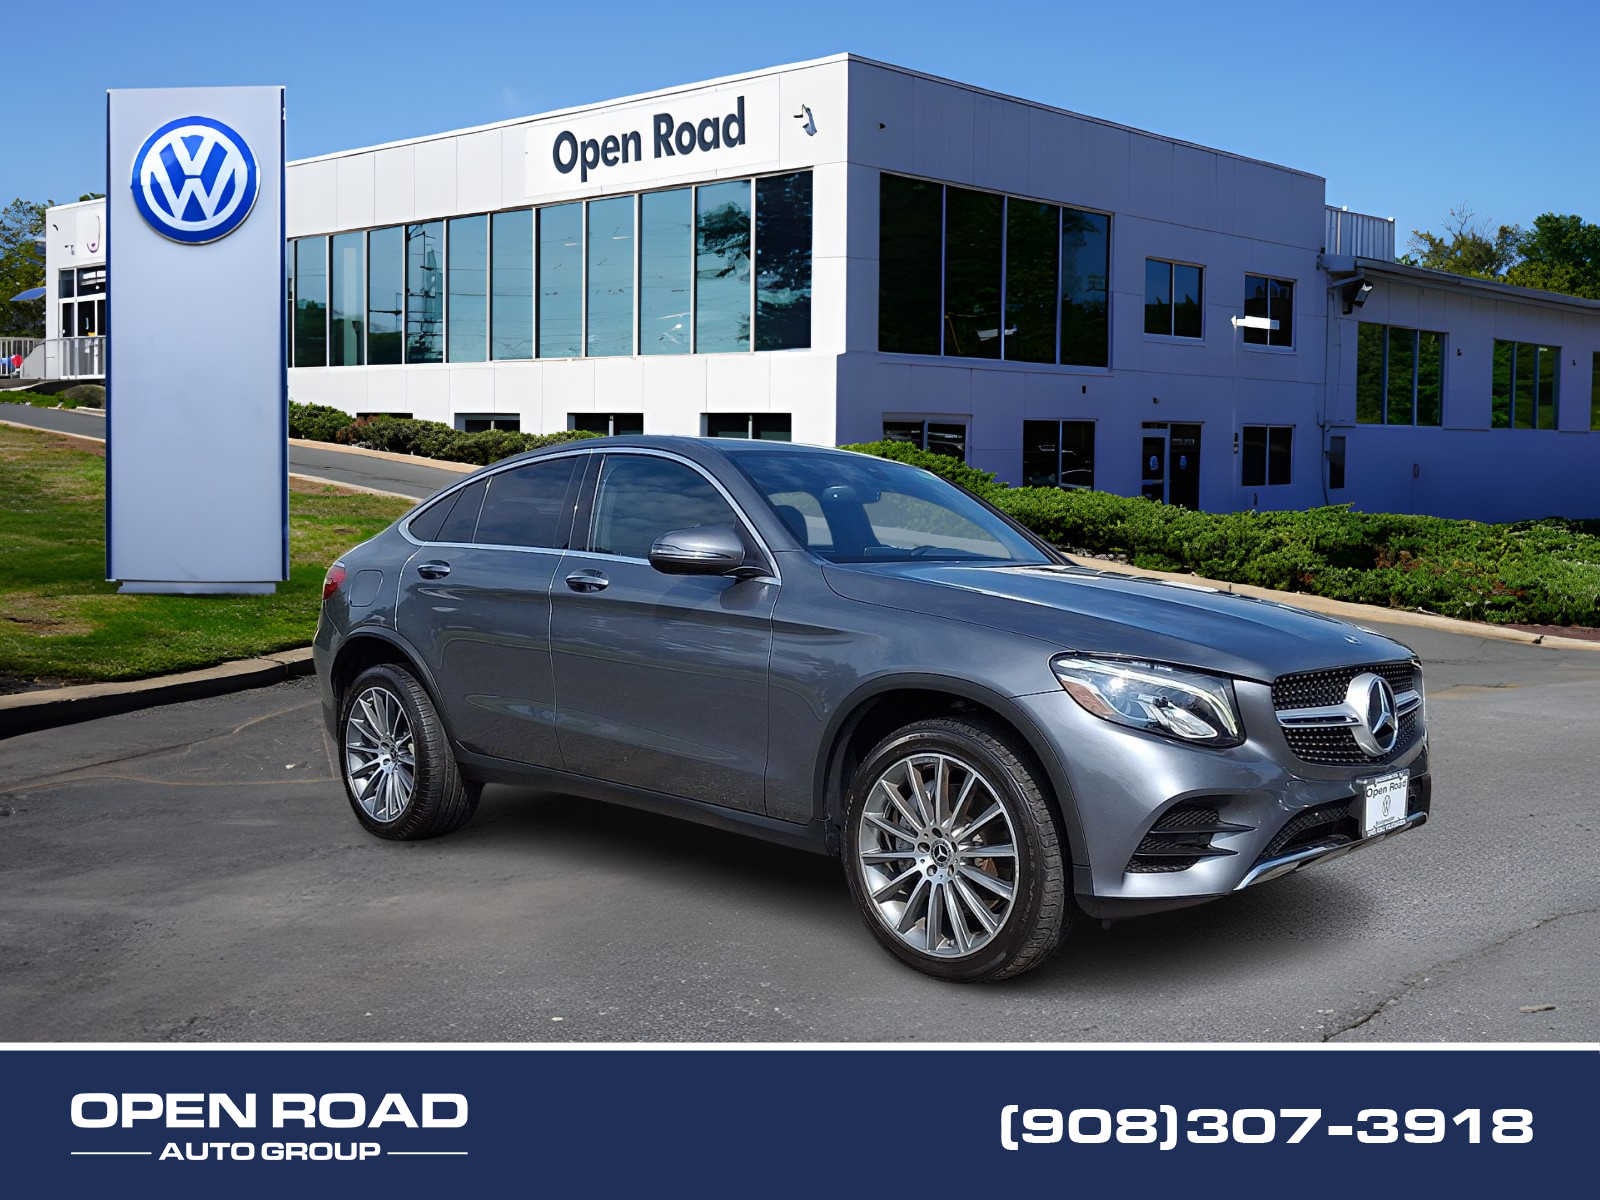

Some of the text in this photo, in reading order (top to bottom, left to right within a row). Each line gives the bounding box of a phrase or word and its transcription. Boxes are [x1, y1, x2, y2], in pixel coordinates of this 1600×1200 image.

[552, 95, 746, 183] Open Road
[1366, 785, 1388, 799] Open
